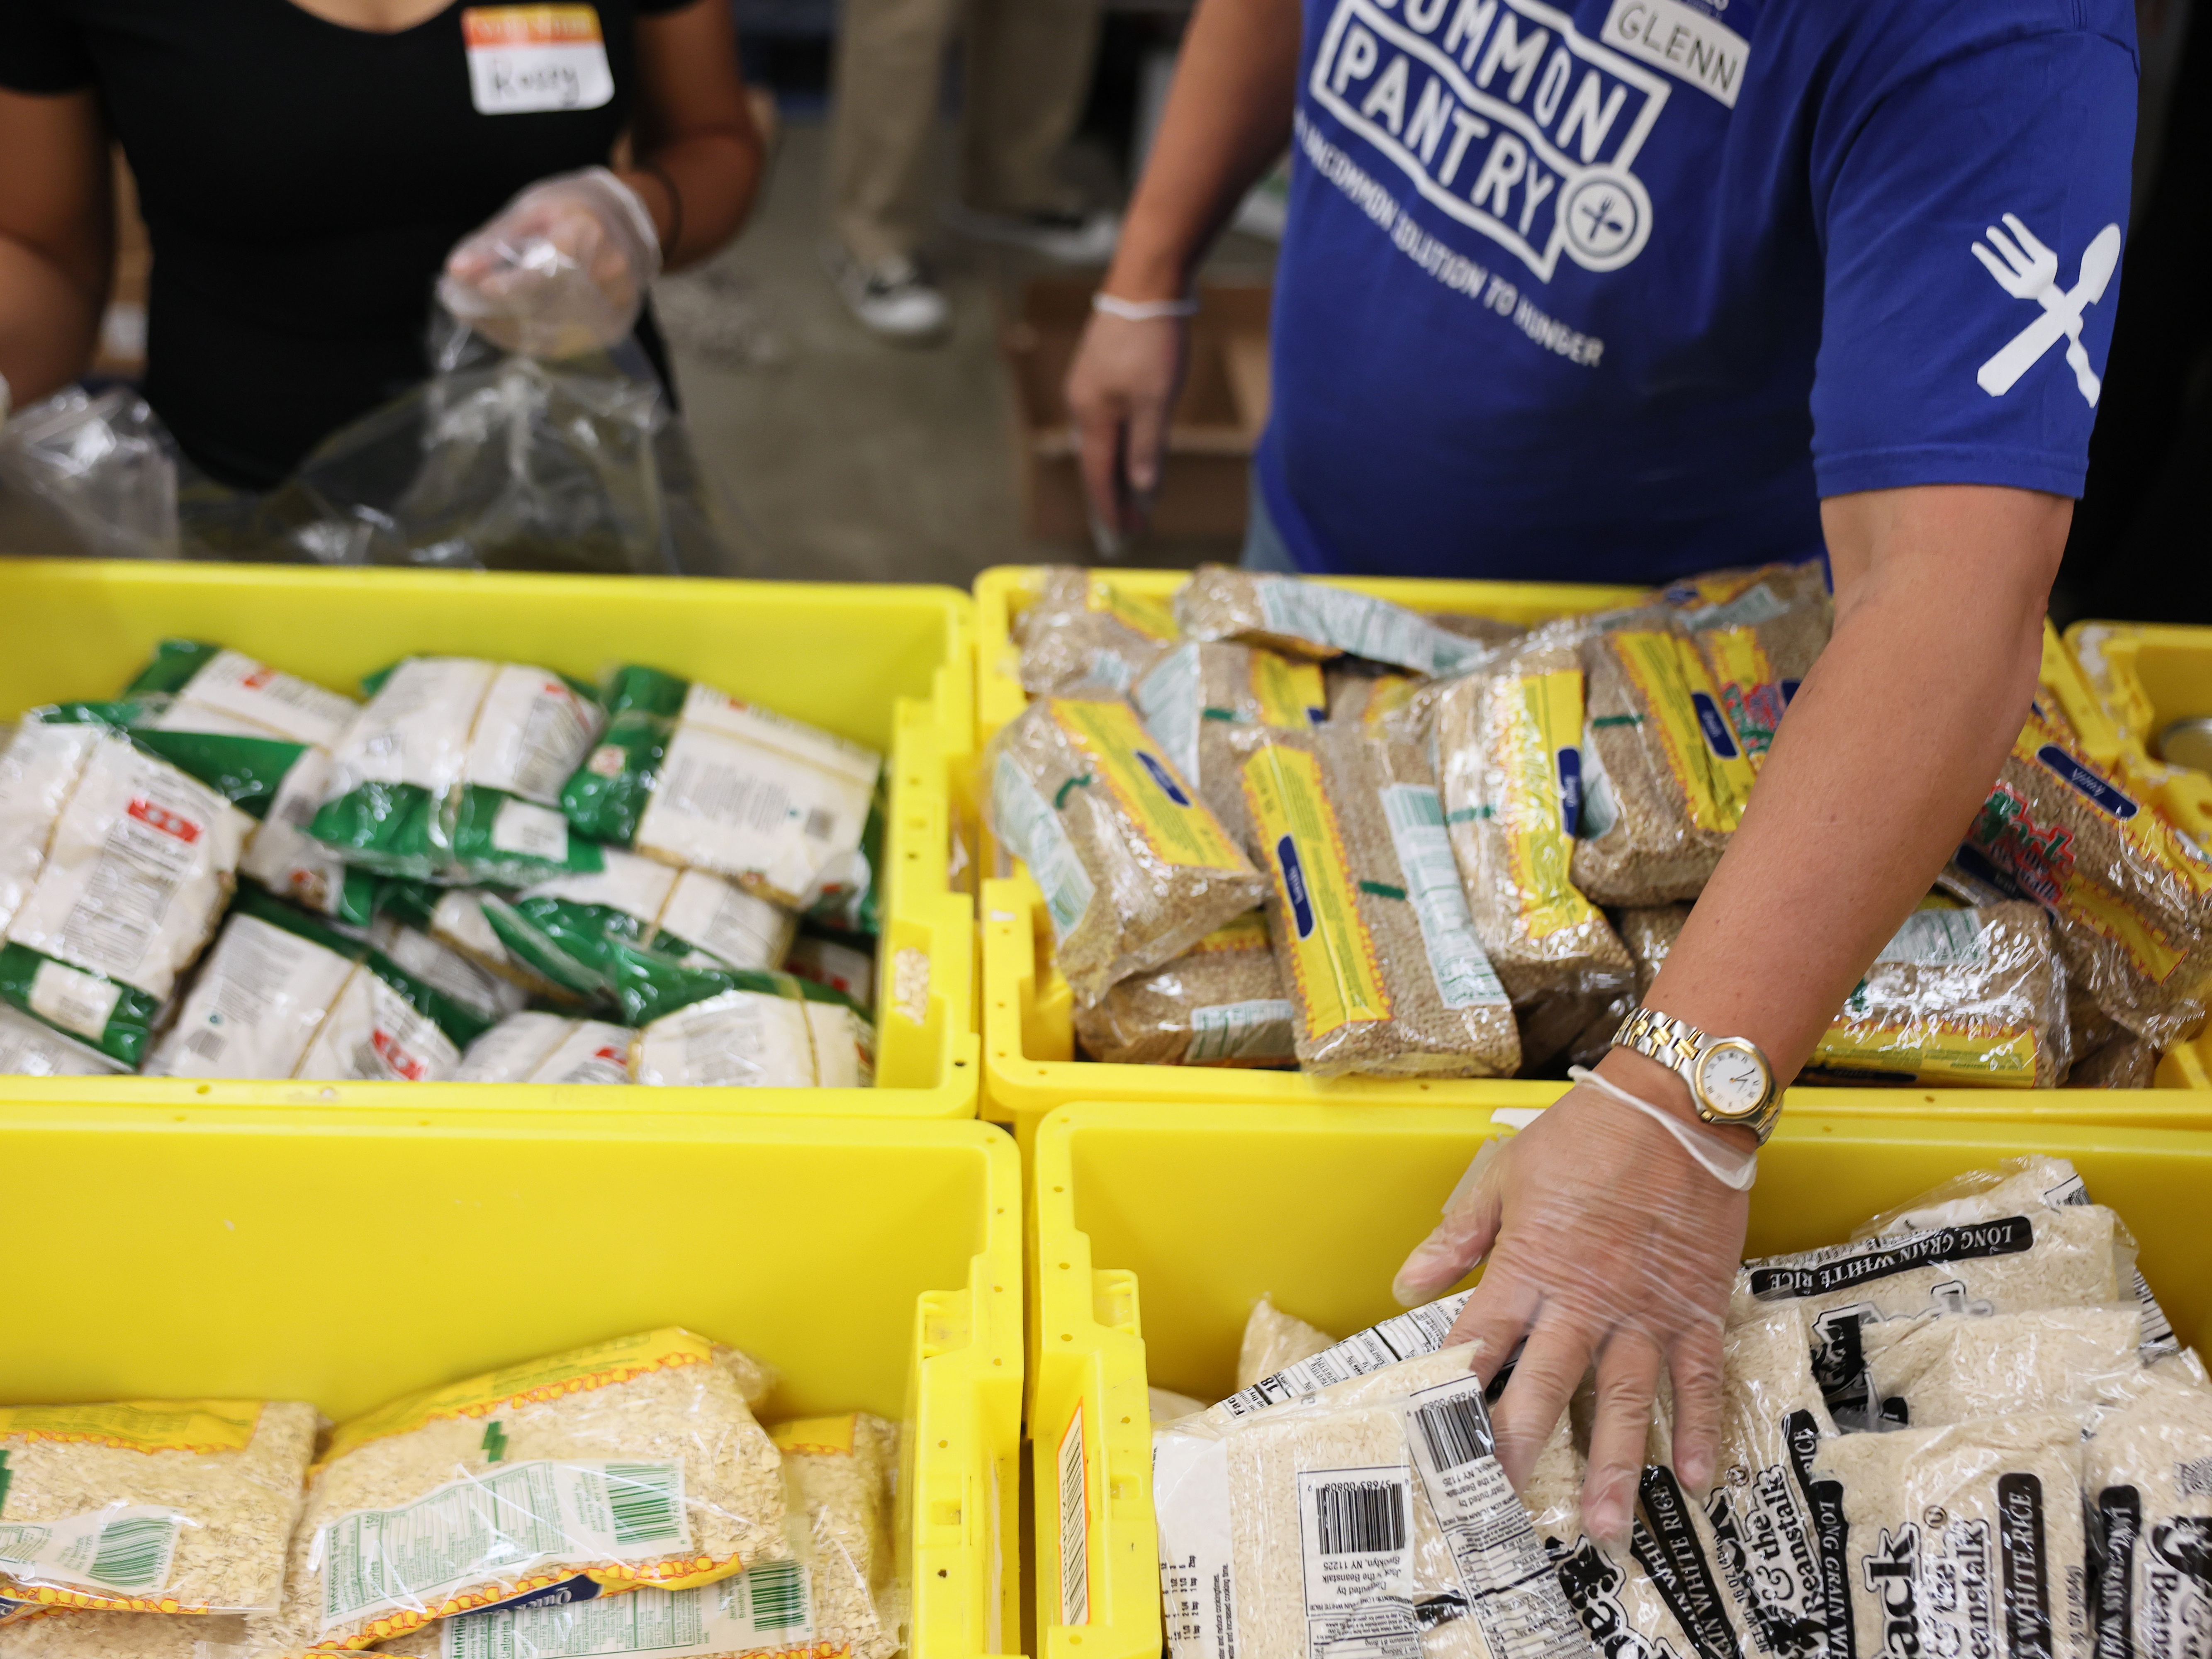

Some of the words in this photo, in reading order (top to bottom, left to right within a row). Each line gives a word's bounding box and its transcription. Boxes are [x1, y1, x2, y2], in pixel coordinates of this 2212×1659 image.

[1618, 2, 1739, 92] GLENN
[1374, 0, 1628, 163] MMON
[1334, 25, 1556, 239] PANTRY
[1483, 273, 1518, 316] TO
[1513, 294, 1604, 367] HUNGER
[1899, 1232, 1955, 1262] GRAIN
[1959, 1224, 2013, 1250] LONG
[1769, 1273, 1813, 1290] RICE
[1818, 1253, 1893, 1285] WHITE
[1365, 1338, 1375, 1352] Sugars
[1373, 1350, 1386, 1365] Added
[1227, 1397, 1246, 1415] Fac
[1249, 1391, 1258, 1401] Dry
[1421, 1398, 1445, 1412] 0080
[1462, 1469, 1475, 1480] NY
[1476, 1477, 1489, 1489] the
[1458, 1500, 1467, 1508] by
[1648, 1484, 1684, 1532] RICE
[2008, 1491, 2035, 1544] RICE
[1741, 1512, 1781, 1562] the
[1819, 1501, 1841, 1549] LONG
[330, 1526, 340, 1561] Facts
[155, 1548, 170, 1577] 57683
[1323, 1560, 1348, 1571] 11225
[1351, 1559, 1362, 1569] NY
[1363, 1572, 1375, 1582] the
[1668, 1535, 1713, 1610] WHITE
[329, 1564, 341, 1612] Nutrition
[369, 1561, 380, 1598] Calories
[1323, 1573, 1360, 1584] Beanstalk
[1336, 1586, 1346, 1595] by
[1724, 1570, 1740, 1588] OZ
[1824, 1556, 1847, 1619] GRAIN
[1956, 1528, 1989, 1658] eanstalk
[2010, 1550, 2041, 1637] WHITE
[738, 1586, 746, 1618] Brooklyn,
[1733, 1589, 1749, 1604] 16
[1870, 1530, 1918, 1659] ack
[452, 1617, 467, 1659] utritio
[499, 1620, 511, 1659] Calories
[1752, 1629, 1771, 1654] NET
